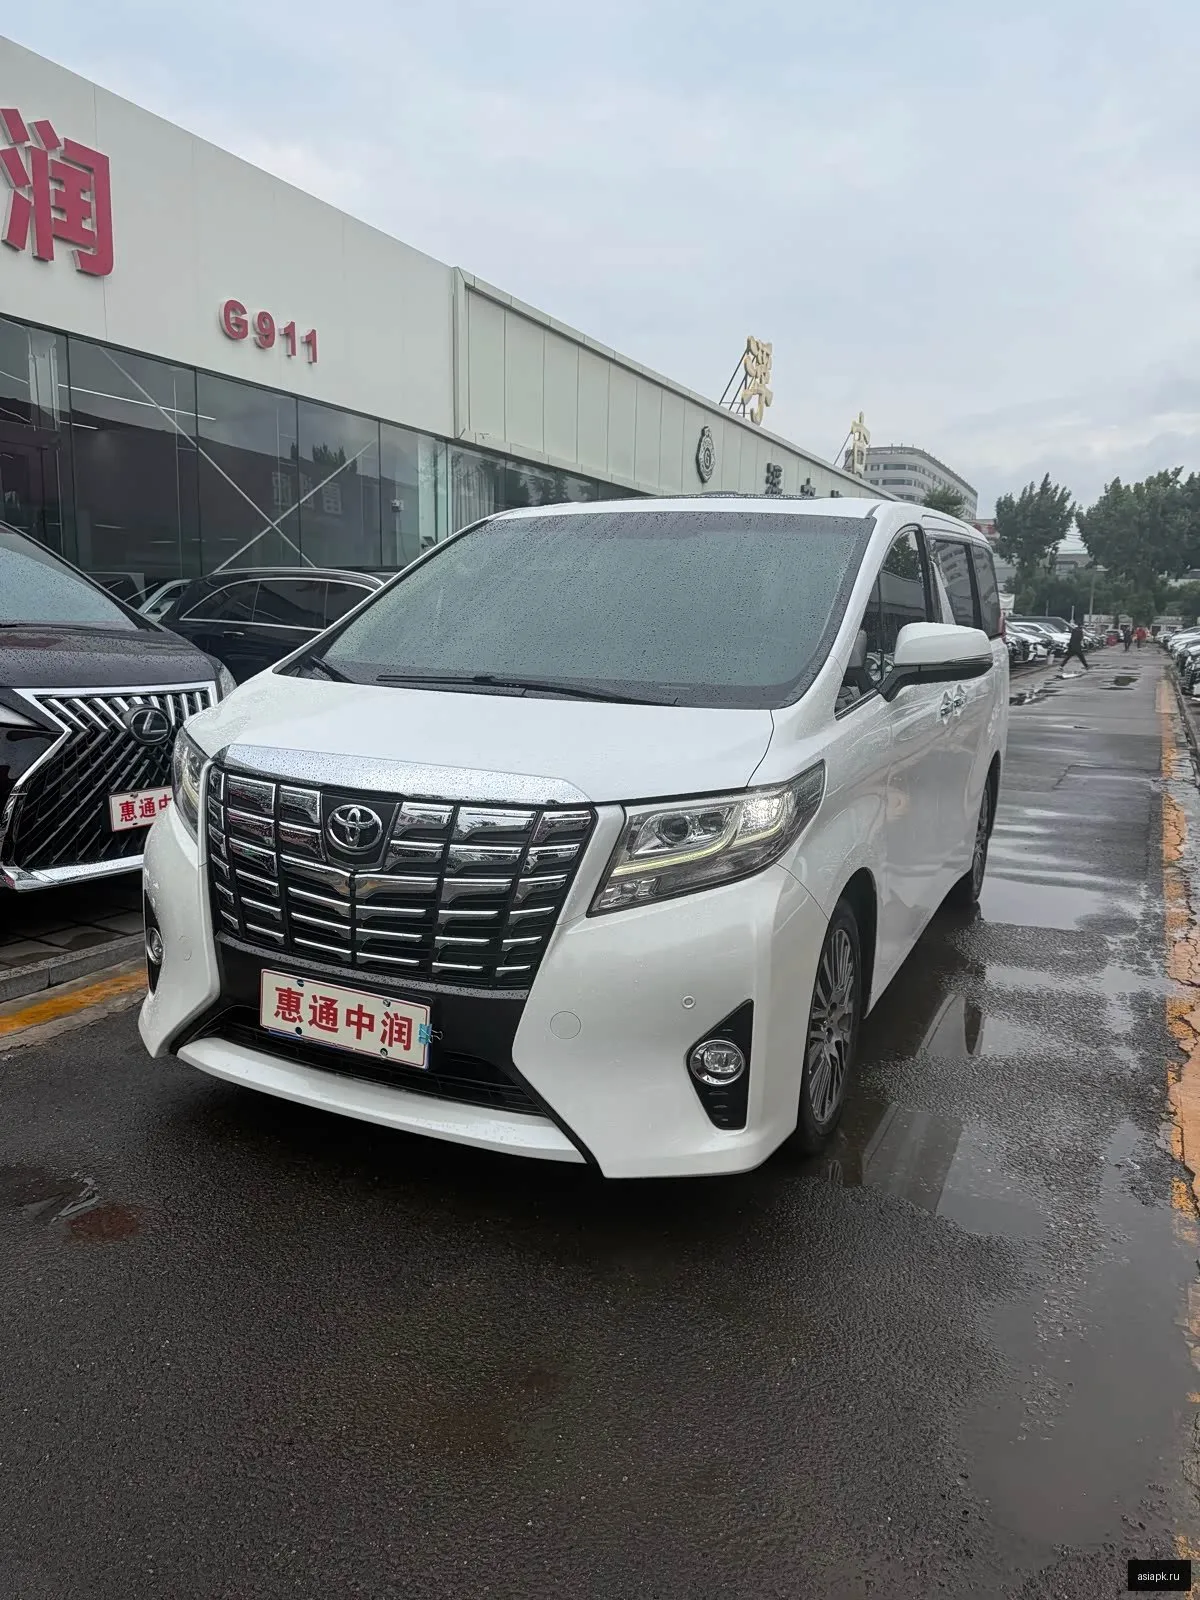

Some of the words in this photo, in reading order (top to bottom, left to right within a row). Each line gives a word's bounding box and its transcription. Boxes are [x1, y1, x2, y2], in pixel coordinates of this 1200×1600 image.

[0, 108, 114, 276] 润
[219, 299, 318, 364] G911
[273, 986, 414, 1052] 惠通中润
